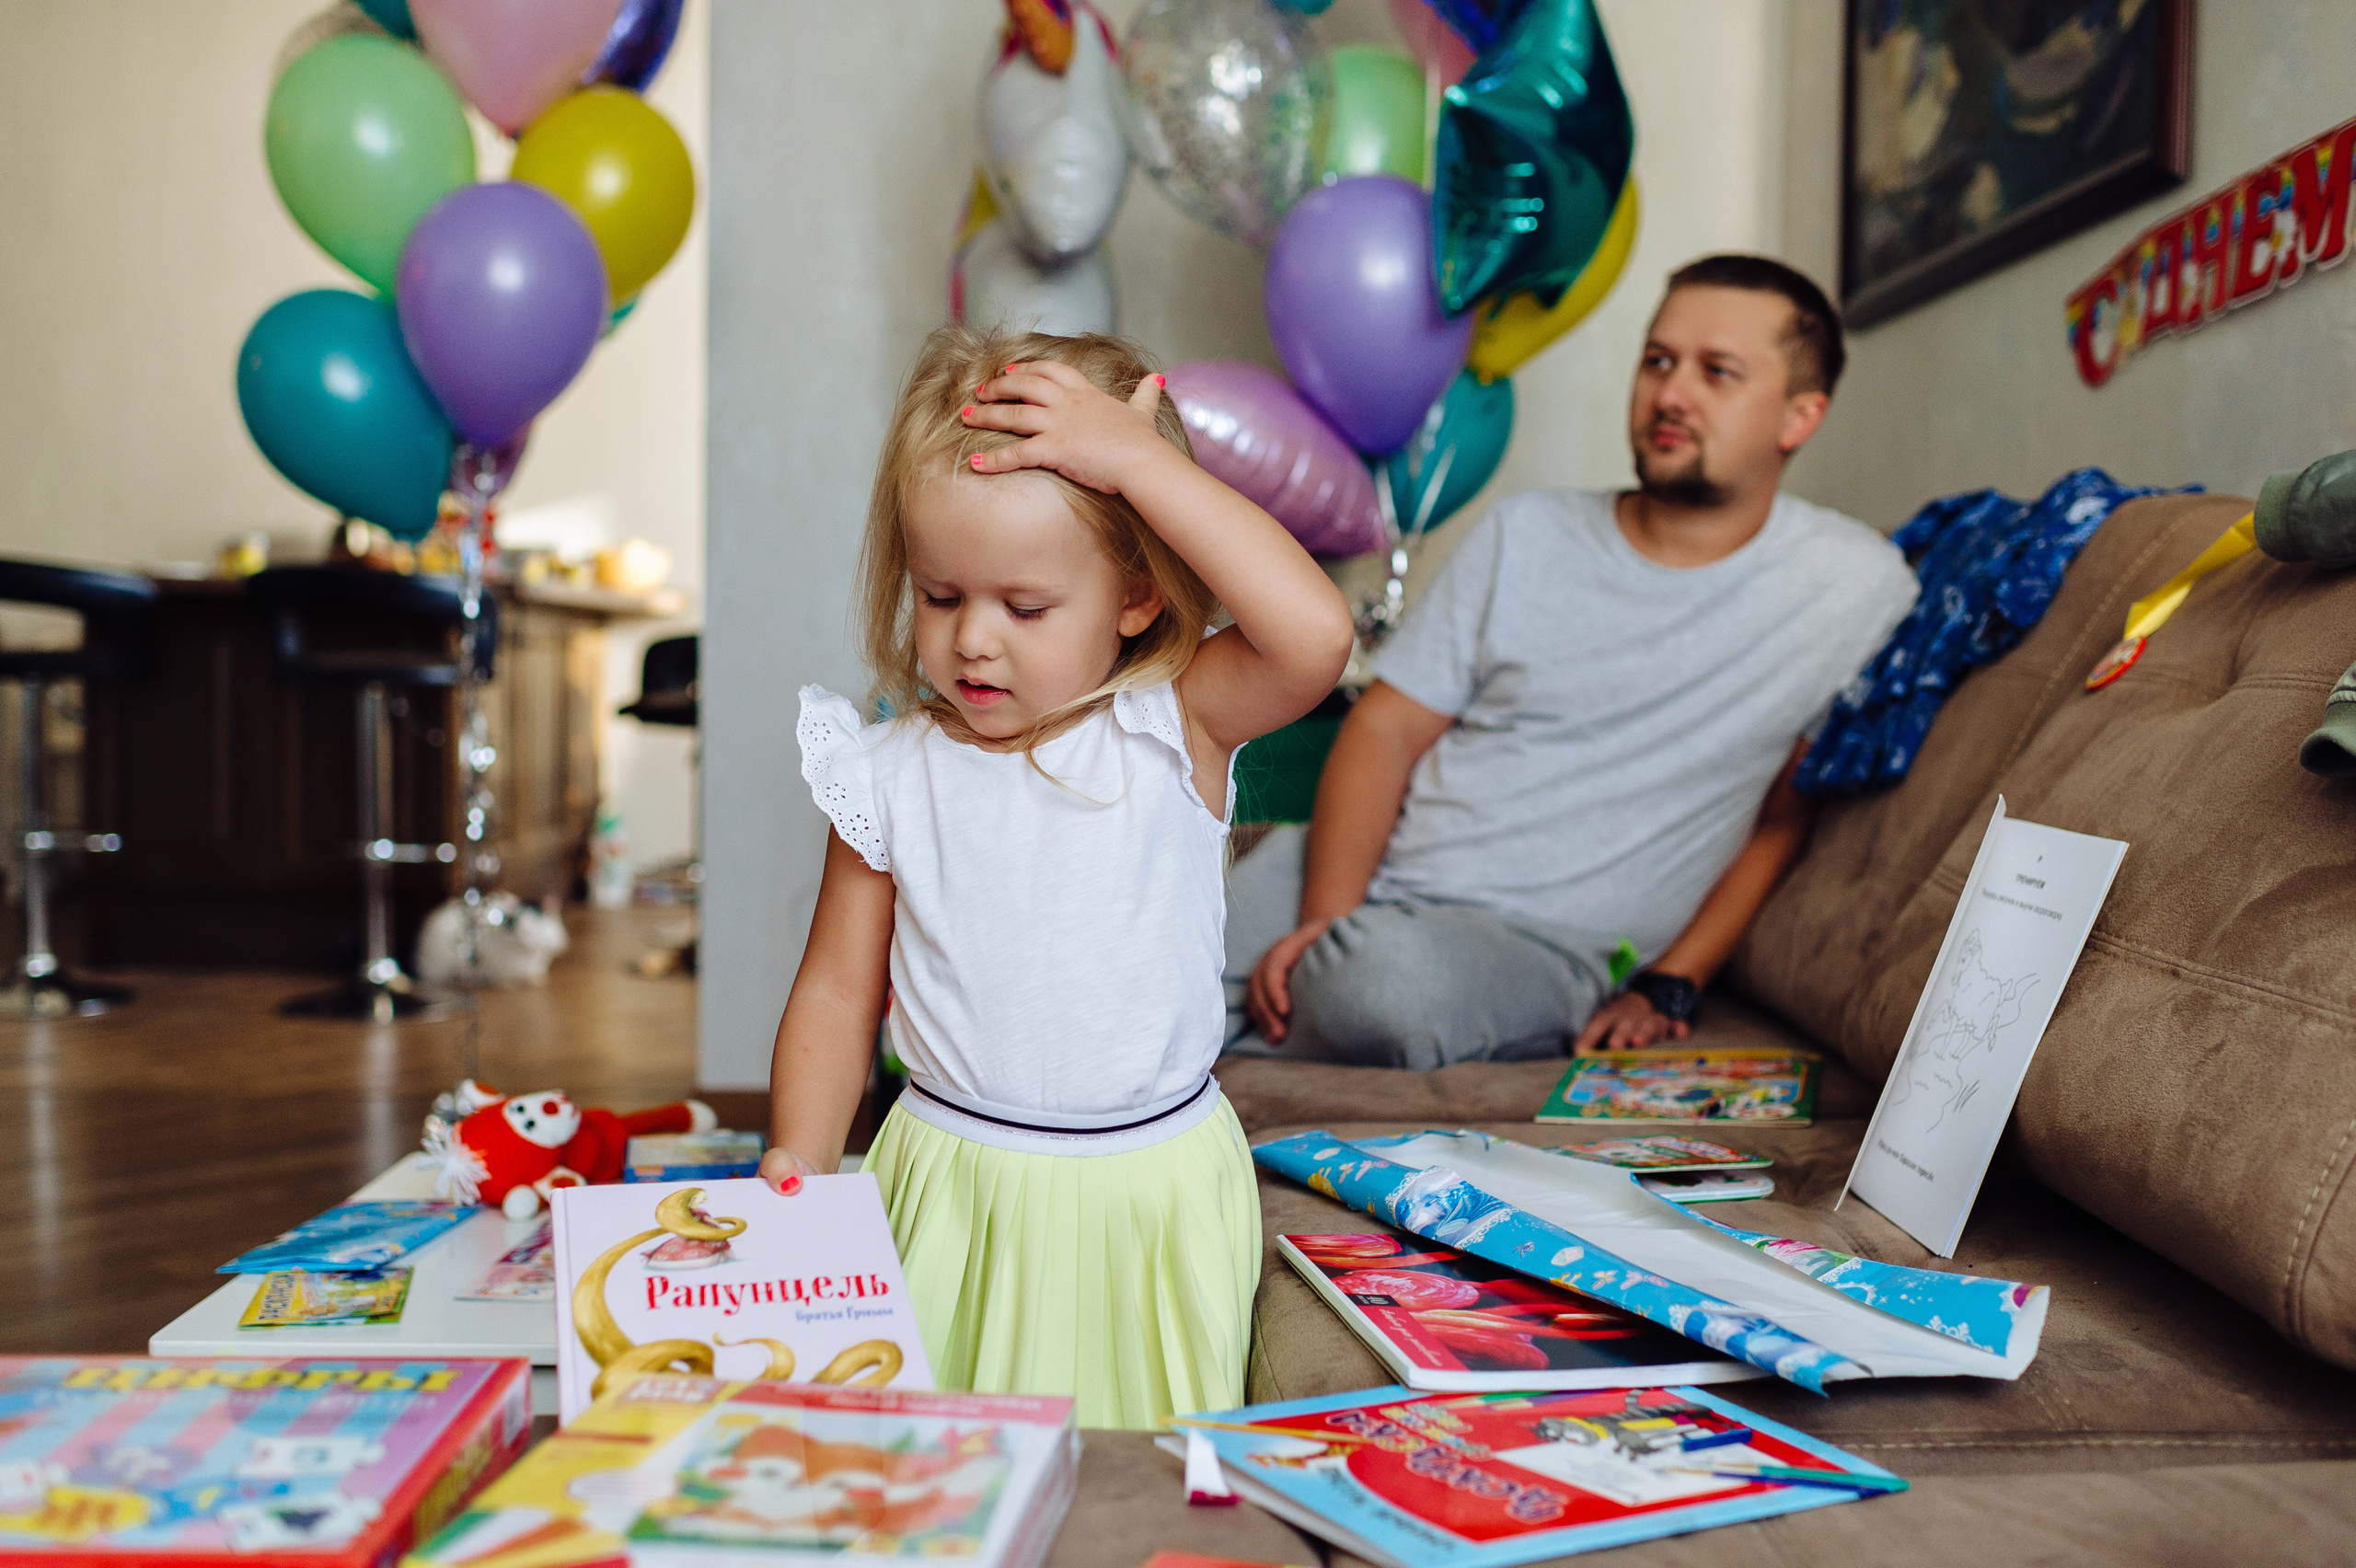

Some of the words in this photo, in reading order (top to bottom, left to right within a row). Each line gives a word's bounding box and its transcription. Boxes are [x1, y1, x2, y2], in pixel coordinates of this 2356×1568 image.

[645, 1274, 890, 1316] Рапунцель
[795, 1310, 842, 1323] Братья
[846, 1306, 893, 1320] Гримм
